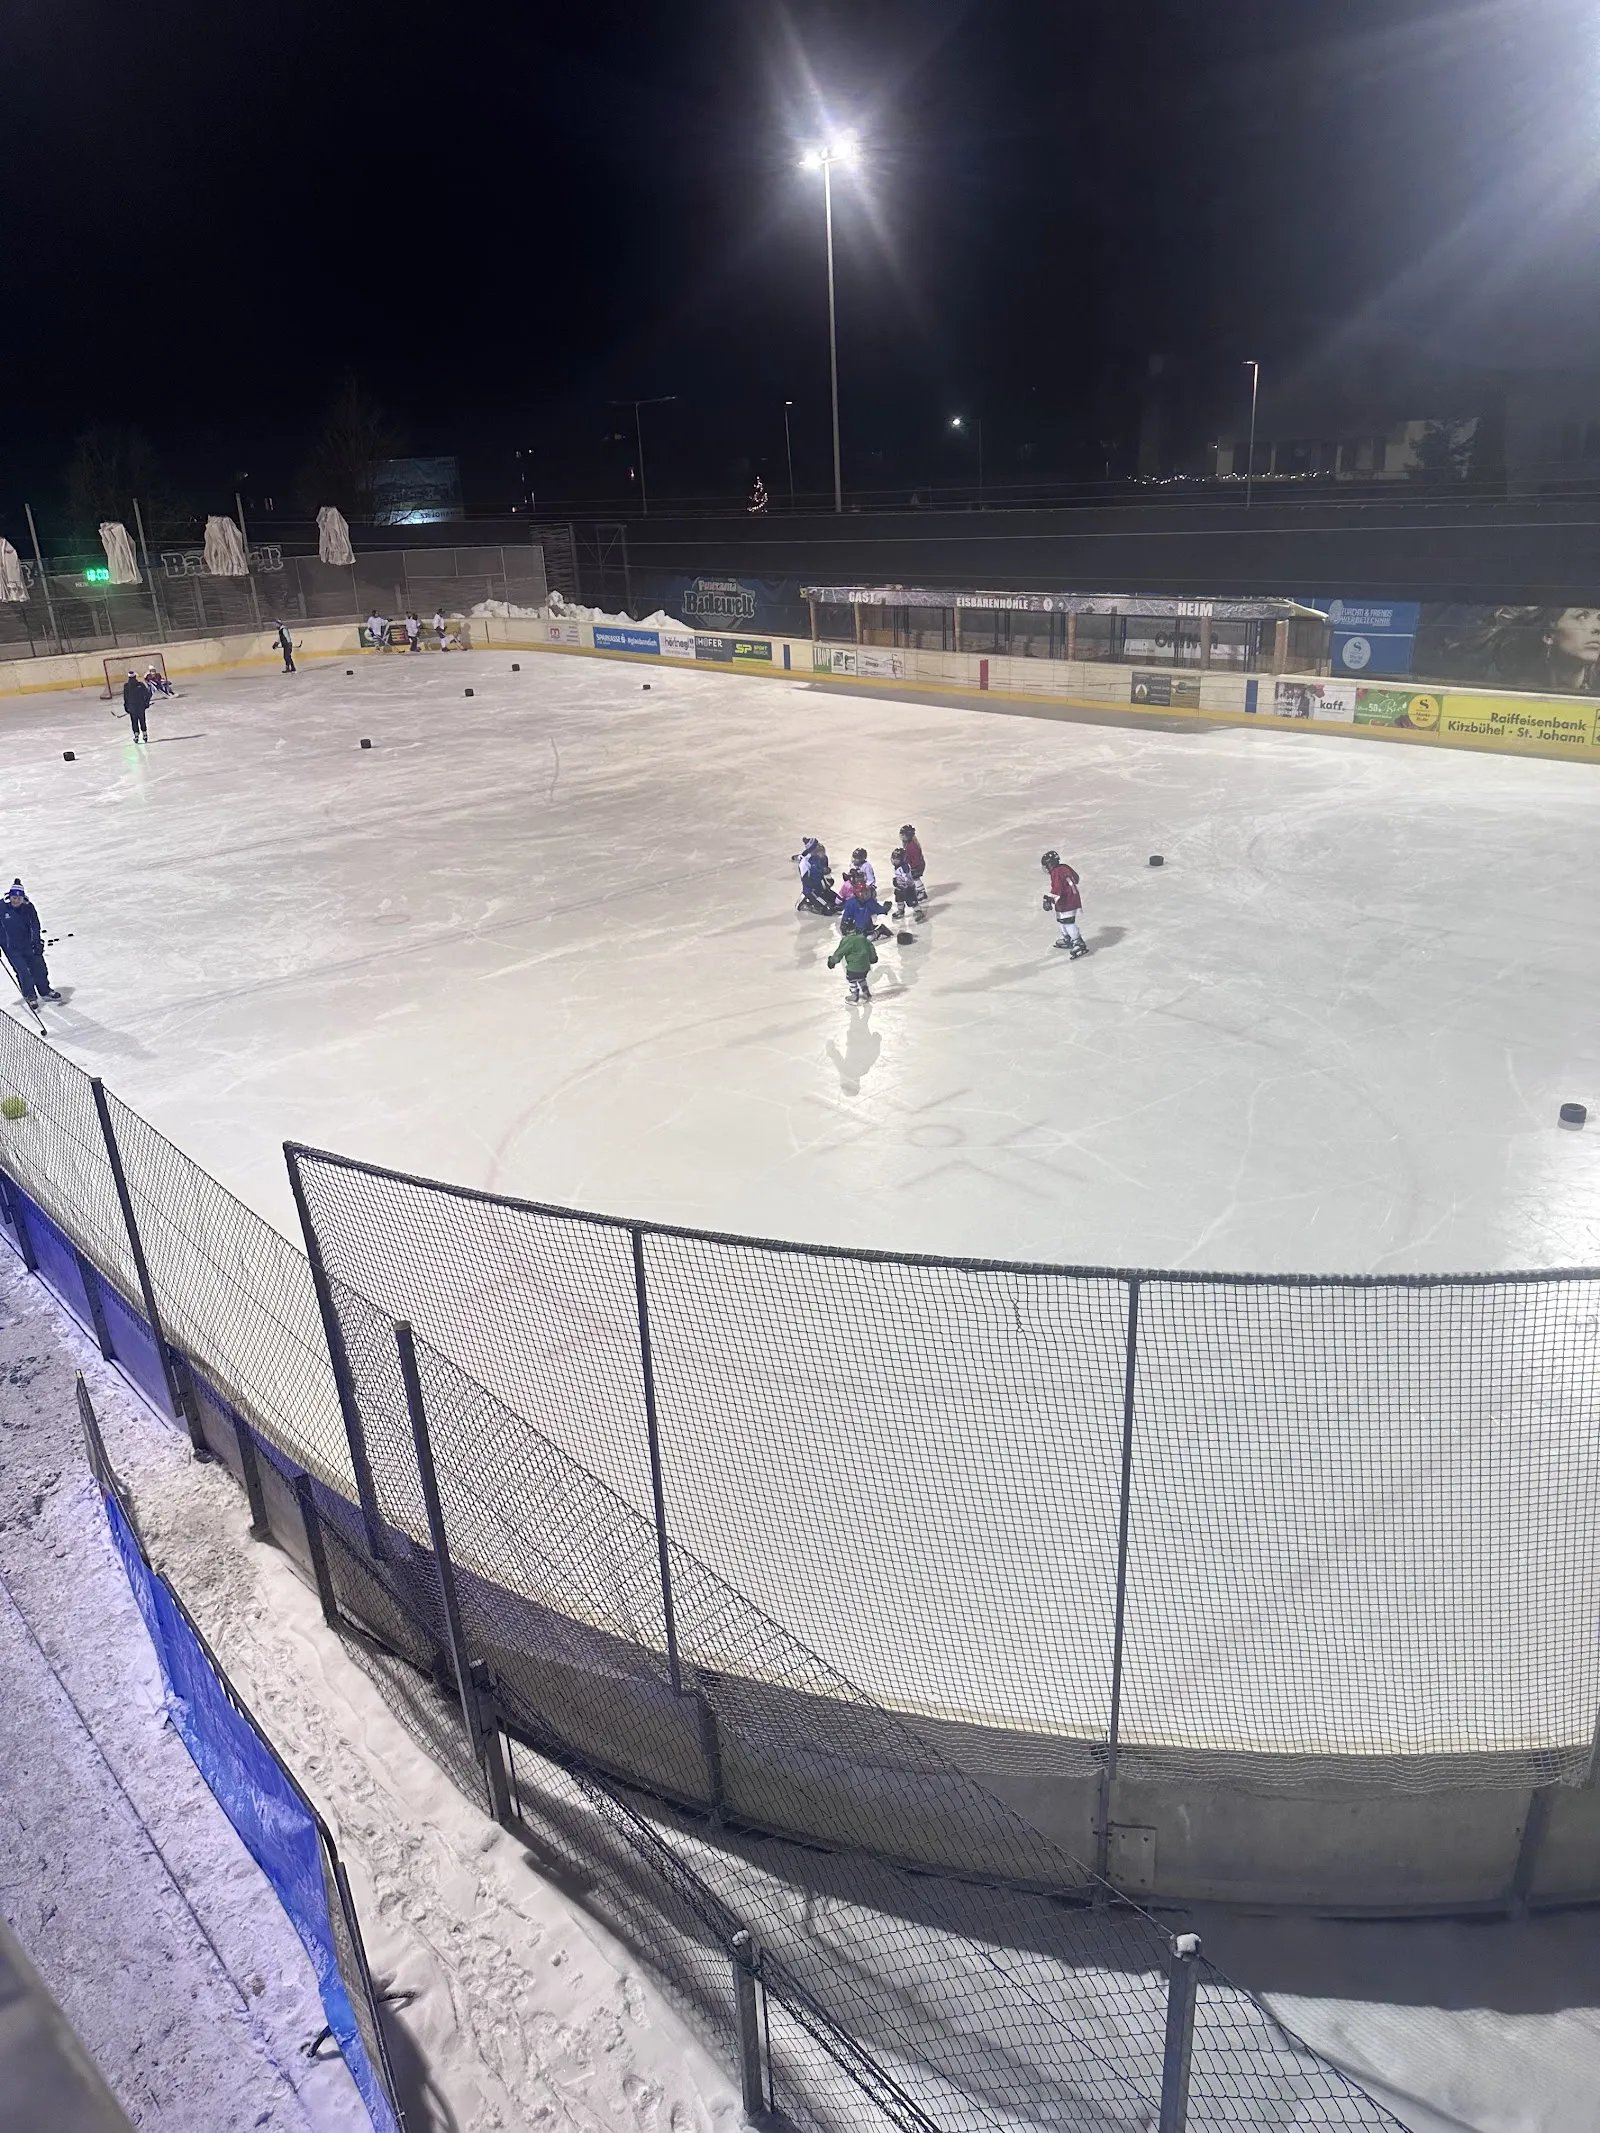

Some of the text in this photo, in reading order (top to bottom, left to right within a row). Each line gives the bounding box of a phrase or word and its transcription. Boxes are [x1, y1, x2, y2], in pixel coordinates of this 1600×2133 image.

[684, 590, 754, 618] Badewelt
[849, 591, 876, 603] GAST
[956, 597, 1029, 610] EISBÄRENHÖHLE
[1177, 602, 1213, 617] HEIM
[596, 633, 621, 643] SPARKASSE
[1490, 712, 1587, 731] Raiffeisenbank
[1448, 720, 1505, 736] Kitzbühel
[1517, 727, 1533, 739] St.
[1536, 729, 1585, 744] Johann
